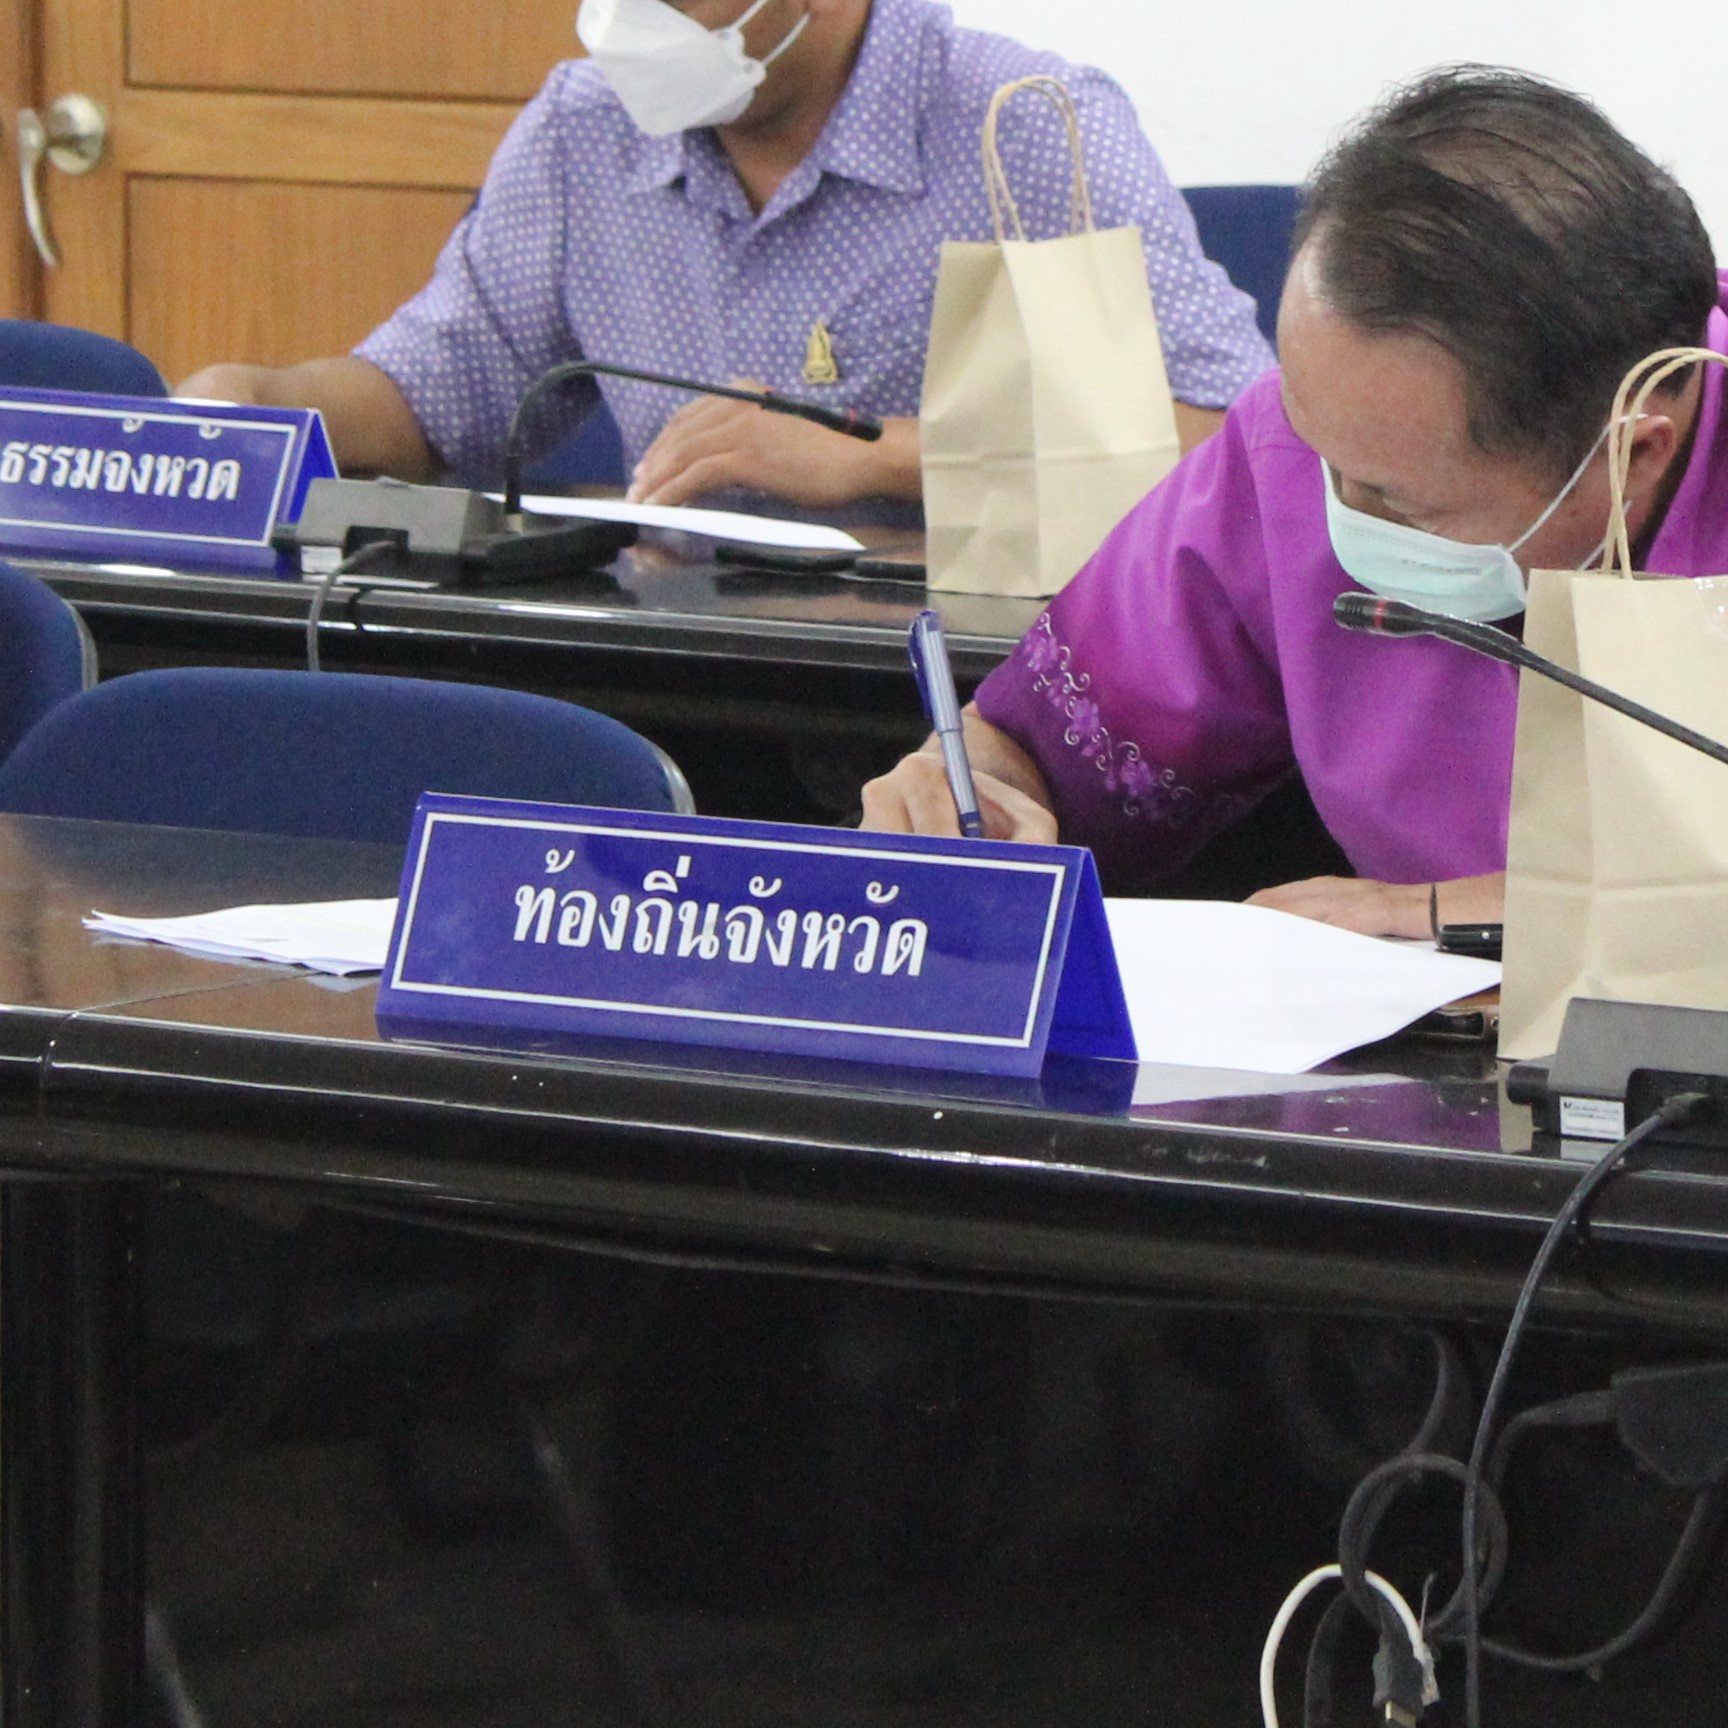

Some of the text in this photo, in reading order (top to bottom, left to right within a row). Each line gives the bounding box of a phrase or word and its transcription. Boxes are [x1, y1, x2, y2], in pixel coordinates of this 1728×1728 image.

[511, 849, 930, 978] ท้องถิ่นจังหวัด
